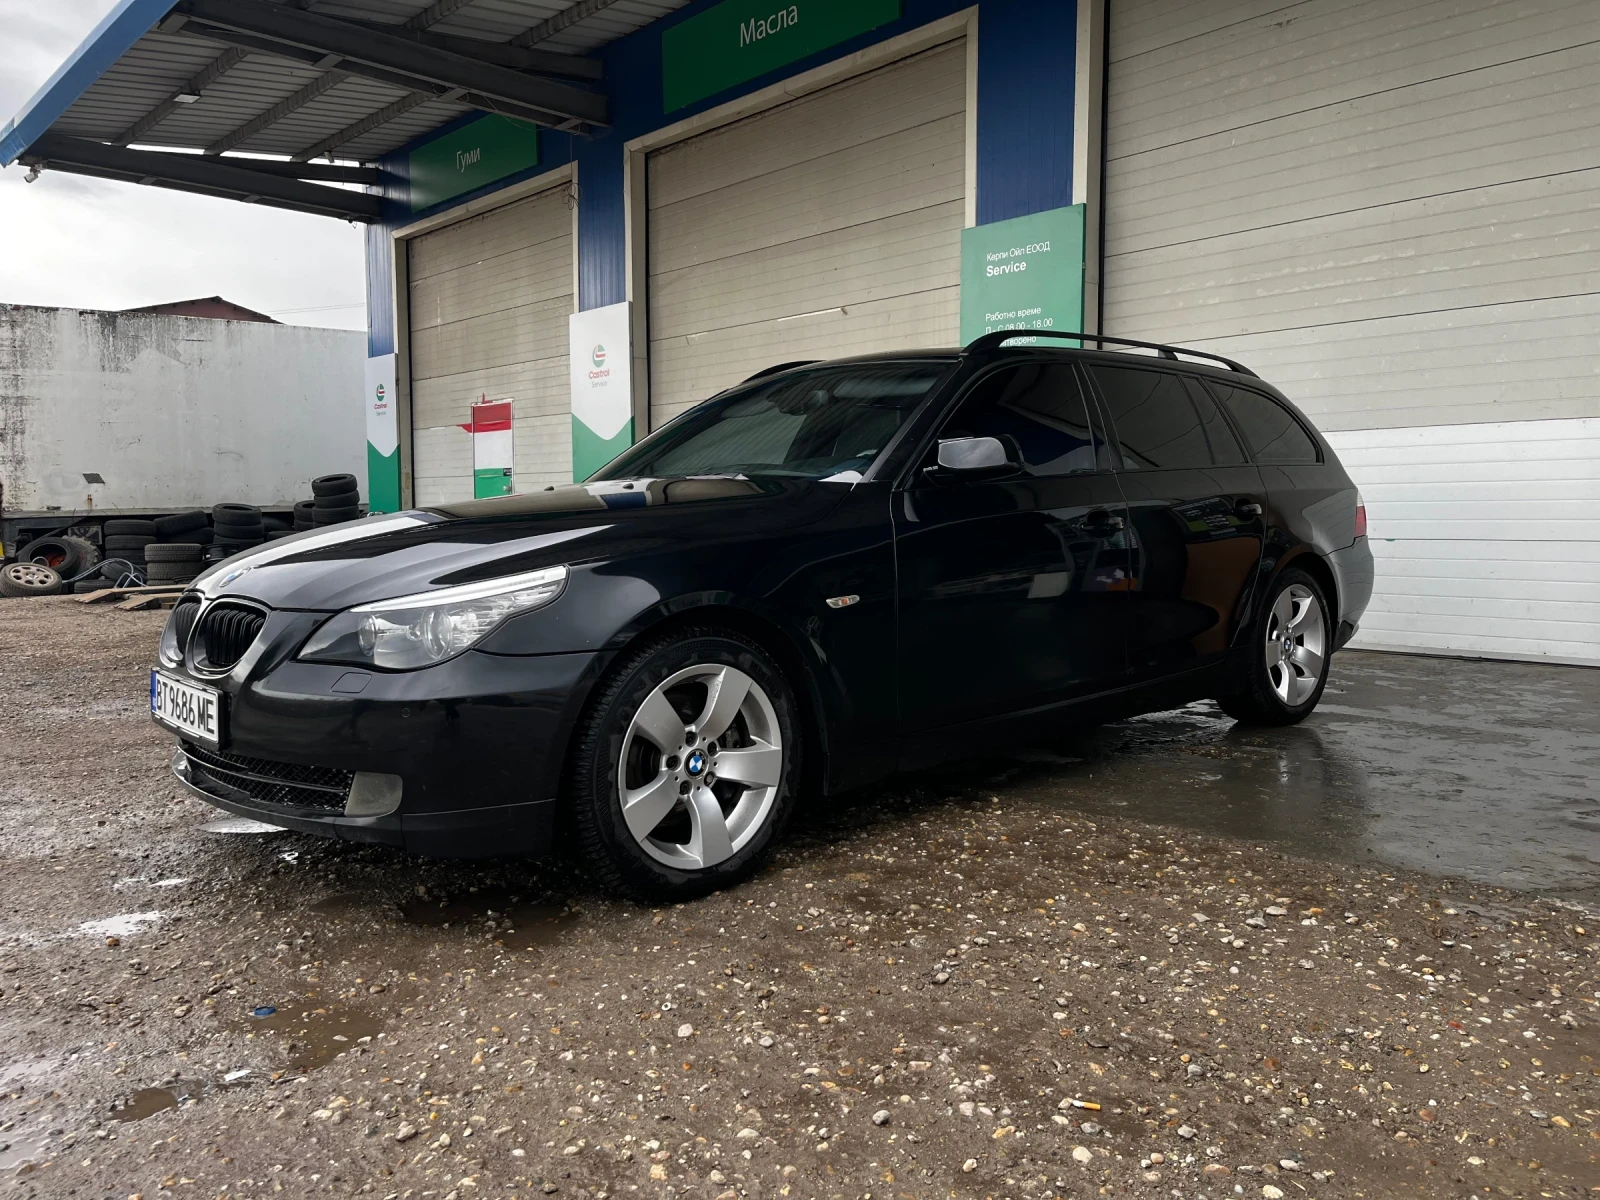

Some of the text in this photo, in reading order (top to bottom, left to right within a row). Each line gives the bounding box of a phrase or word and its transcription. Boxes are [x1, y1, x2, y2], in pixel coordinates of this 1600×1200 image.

[740, 5, 798, 48] Масла
[456, 147, 480, 173] Гуми
[1009, 247, 1025, 257] Ойл
[1026, 241, 1050, 254] ЕООД
[986, 261, 1027, 277] Service
[985, 307, 1041, 322] Работно време
[1004, 321, 1026, 331] 0800
[1032, 317, 1053, 329] 18.00
[1000, 336, 1037, 346] атворено
[589, 368, 610, 380] Castrol
[169, 684, 196, 726] 9686
[197, 695, 215, 735] ME
